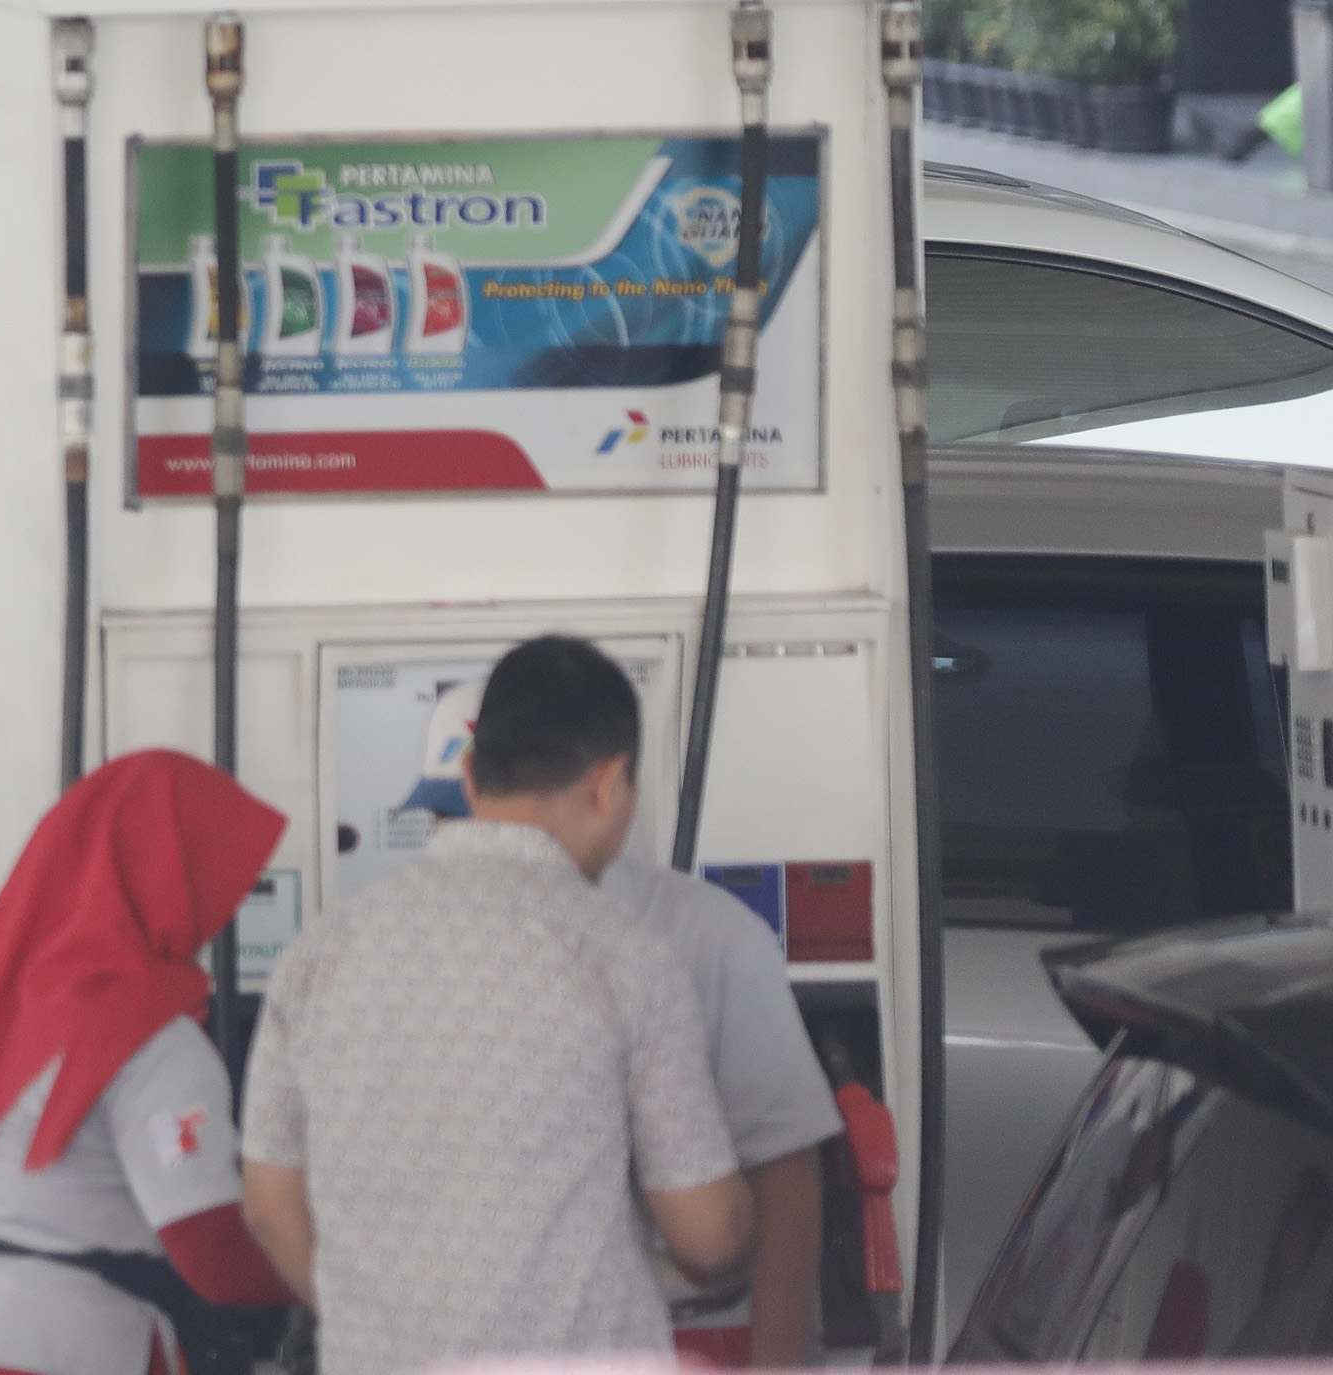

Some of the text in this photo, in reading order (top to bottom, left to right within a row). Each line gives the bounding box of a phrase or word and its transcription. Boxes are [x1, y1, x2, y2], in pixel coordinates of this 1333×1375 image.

[339, 162, 496, 187] PERTAMINA
[297, 191, 548, 233] Fastron
[483, 276, 769, 302] Protecting to the Nano Thg
[659, 426, 783, 445] PERTAINA
